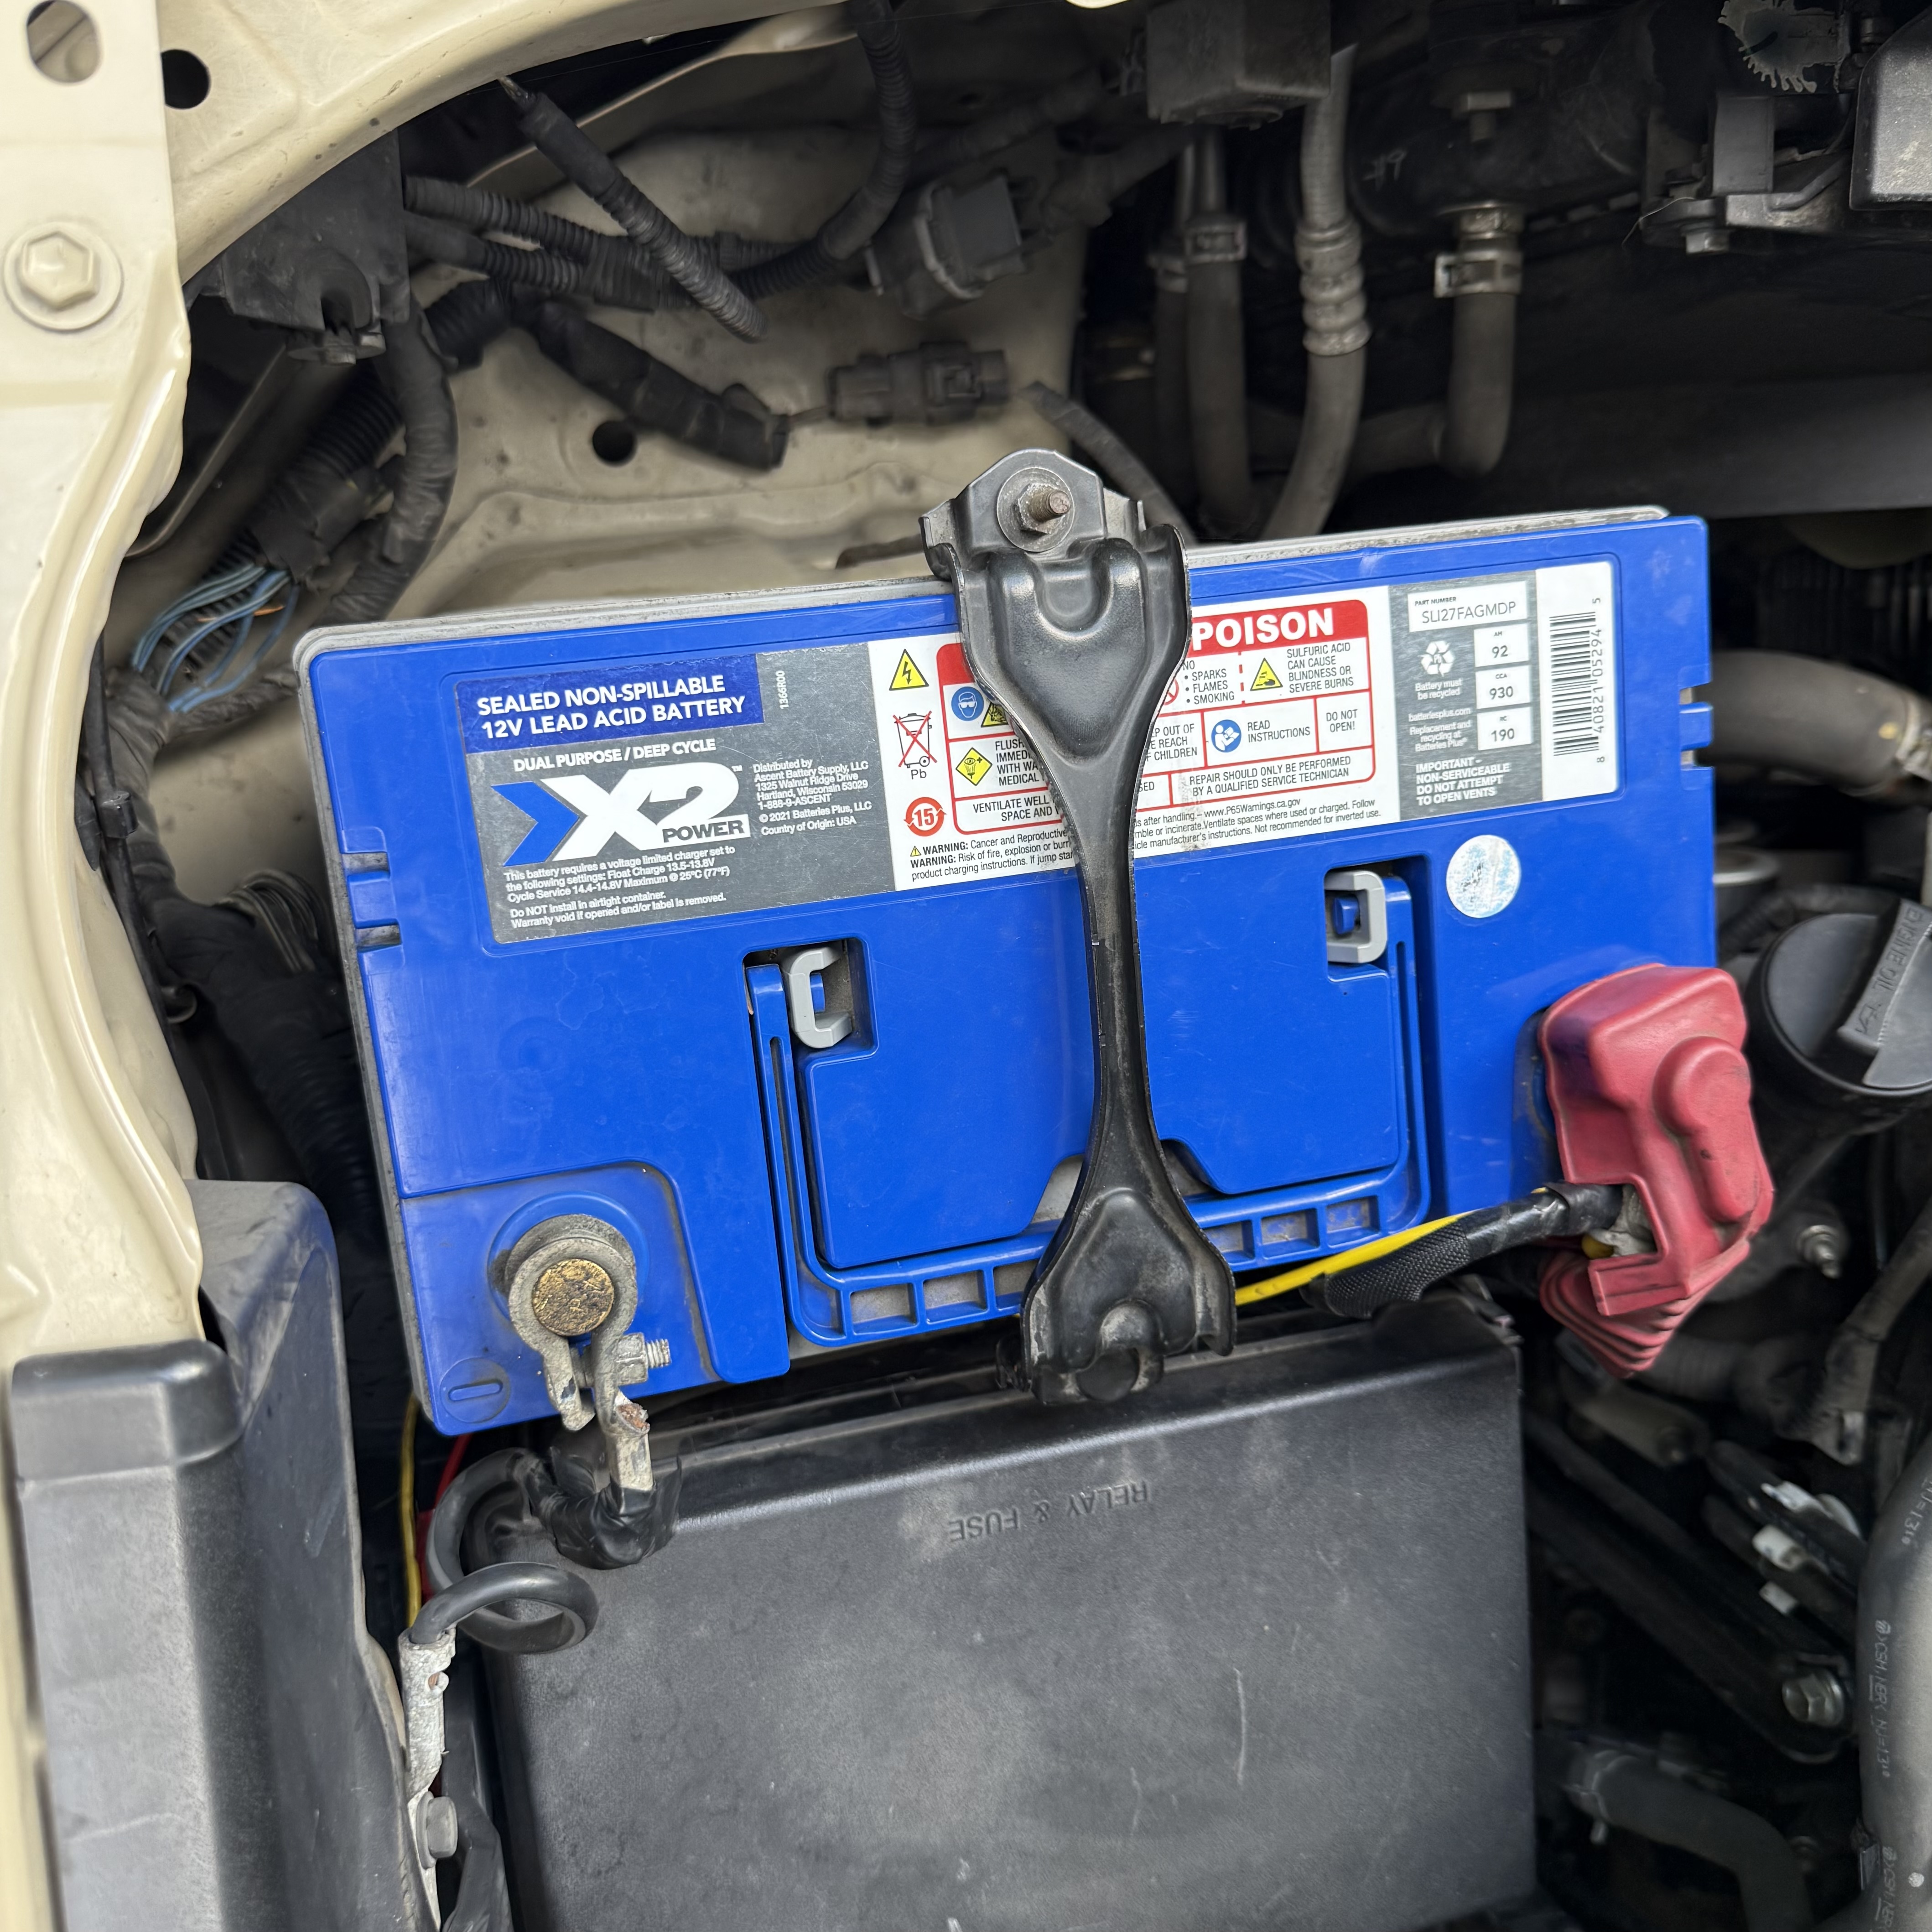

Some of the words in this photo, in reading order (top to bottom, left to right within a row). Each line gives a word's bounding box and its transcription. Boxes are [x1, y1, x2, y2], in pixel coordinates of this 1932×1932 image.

[1422, 601, 1516, 623] SLI27FAGMDP
[1191, 608, 1333, 650] POISON
[1287, 644, 1328, 658] SULFURIC
[1331, 642, 1350, 653] ACID
[1492, 645, 1508, 658] 92
[1591, 628, 1603, 677] 05294
[1288, 660, 1305, 670] CAN
[1308, 655, 1336, 667] CAUSE
[1192, 668, 1226, 681] SPARKS
[1288, 667, 1336, 681] BLINDNESS
[1193, 680, 1228, 693] FLAMES
[1289, 680, 1322, 693] SEVERE
[1324, 677, 1354, 689] BURNS
[1415, 682, 1443, 693] Battery
[1444, 678, 1462, 689] must
[1429, 688, 1460, 698] recycled
[1490, 686, 1513, 700] 930
[477, 691, 560, 716] SEALED
[565, 675, 725, 707] NON-SPILLABLE
[1194, 691, 1234, 705] SMOKING
[482, 718, 522, 738] 12V
[530, 713, 588, 734] LEAD
[594, 707, 646, 727] ACID
[652, 696, 745, 721] BATTERY
[1326, 712, 1338, 722] DO
[1341, 709, 1358, 720] NOT
[1408, 708, 1471, 722] batteriesplus.com
[1593, 686, 1604, 733] 40821
[1163, 725, 1180, 736] OUT
[1247, 720, 1270, 731] READ
[1330, 721, 1355, 732] OPEN!
[1410, 722, 1456, 736] Replacement
[1159, 736, 1187, 748] REACH
[1248, 727, 1310, 743] INSTRUCTIONS
[1422, 732, 1452, 743] recycling
[1491, 728, 1514, 742] 190
[513, 756, 555, 772] DUAL
[556, 748, 622, 767] PURPOSE
[633, 743, 670, 759] DEEP
[672, 738, 716, 754] CYCLE
[1154, 747, 1197, 760] CHILDREN
[1415, 741, 1447, 752] Batteries
[753, 759, 800, 773] Distributed
[754, 771, 785, 784] Ascent
[785, 766, 817, 780] Battery
[817, 763, 849, 775] Supply,
[850, 761, 869, 771] LLC
[997, 763, 1020, 774] WITH
[1189, 773, 1220, 785] REPAIR
[1223, 768, 1257, 781] SHOULD
[1261, 764, 1283, 776] ONLY
[1285, 763, 1297, 773] BE
[1299, 756, 1350, 771] PERFORMED
[1416, 756, 1475, 773] IMPORTANT
[1416, 763, 1511, 784] NON-SERVICEABLE
[755, 781, 778, 791] 1325
[778, 778, 809, 789] Walnut
[809, 774, 835, 785] Ridge
[835, 771, 858, 782] Drive
[911, 769, 927, 779] Pb
[999, 773, 1039, 786] MEDICAL
[1215, 779, 1258, 793] QUALIFIED
[1262, 774, 1297, 787] SERVICE
[1298, 768, 1349, 782] TECHNICIAN
[756, 789, 796, 802] Hartland,
[796, 783, 841, 798] Wisconsin
[841, 779, 868, 790] 53029
[1417, 784, 1433, 795] DO
[1434, 781, 1456, 793] NOT
[1457, 774, 1504, 789] ATTEMPT
[758, 793, 831, 810] 1-888-9-ASCENT
[973, 798, 1022, 813] VENTILATE
[1024, 795, 1050, 806] WELL
[1417, 795, 1432, 806] TO
[1433, 791, 1462, 804] OPEN
[1463, 787, 1496, 799] VENTS
[769, 810, 790, 821] 2021
[792, 807, 831, 819] Batteries
[831, 805, 853, 814] Plus,
[854, 801, 872, 811] LLC
[913, 808, 934, 828] 15
[1001, 809, 1031, 821] SPACE
[1034, 806, 1052, 817] AND
[1237, 815, 1263, 826] spaces
[1319, 802, 1350, 813] charged.
[1352, 799, 1375, 809] Follow
[662, 820, 744, 843] POWER
[761, 824, 795, 836] Country
[807, 819, 835, 830] Origin:
[836, 815, 857, 826] USA
[1208, 827, 1252, 839] instructions.
[1270, 816, 1321, 831] recommended
[1335, 810, 1364, 822] inverted
[910, 855, 956, 868] WARNING:
[958, 852, 976, 862] Risk
[987, 850, 1002, 858] fire,
[1005, 844, 1041, 857] explosion
[923, 841, 968, 855] WARNING:
[971, 839, 998, 849] Cancer
[504, 871, 528, 885] This
[527, 868, 559, 881] battery
[561, 862, 598, 875] requires
[607, 858, 641, 871] voltage
[642, 852, 673, 864] limited
[674, 850, 708, 860] charger
[523, 878, 566, 892] following
[566, 873, 606, 884] settings:
[607, 868, 631, 879] Float
[631, 866, 665, 876] Charge
[666, 857, 715, 872] 13.5-13.8V
[912, 868, 942, 882] product
[945, 864, 978, 875] charging
[981, 858, 1028, 870] instructions.
[1037, 854, 1057, 865] jump
[507, 891, 535, 904] Cycle
[536, 886, 571, 899] Service
[572, 879, 622, 894] 14.4-14.8V
[623, 873, 668, 888] Maximum
[510, 916, 554, 928] Warranty
[584, 906, 620, 920] opened
[621, 903, 651, 914] and/or
[652, 899, 674, 910] label
[685, 892, 727, 906] removed.
[525, 904, 548, 916] NOT
[549, 901, 577, 913] install
[589, 896, 621, 908] airtight
[622, 892, 666, 904] container.
[1067, 1481, 1151, 1517] RELAY
[1034, 1500, 1050, 1523] &
[949, 1507, 1020, 1542] FUSE
